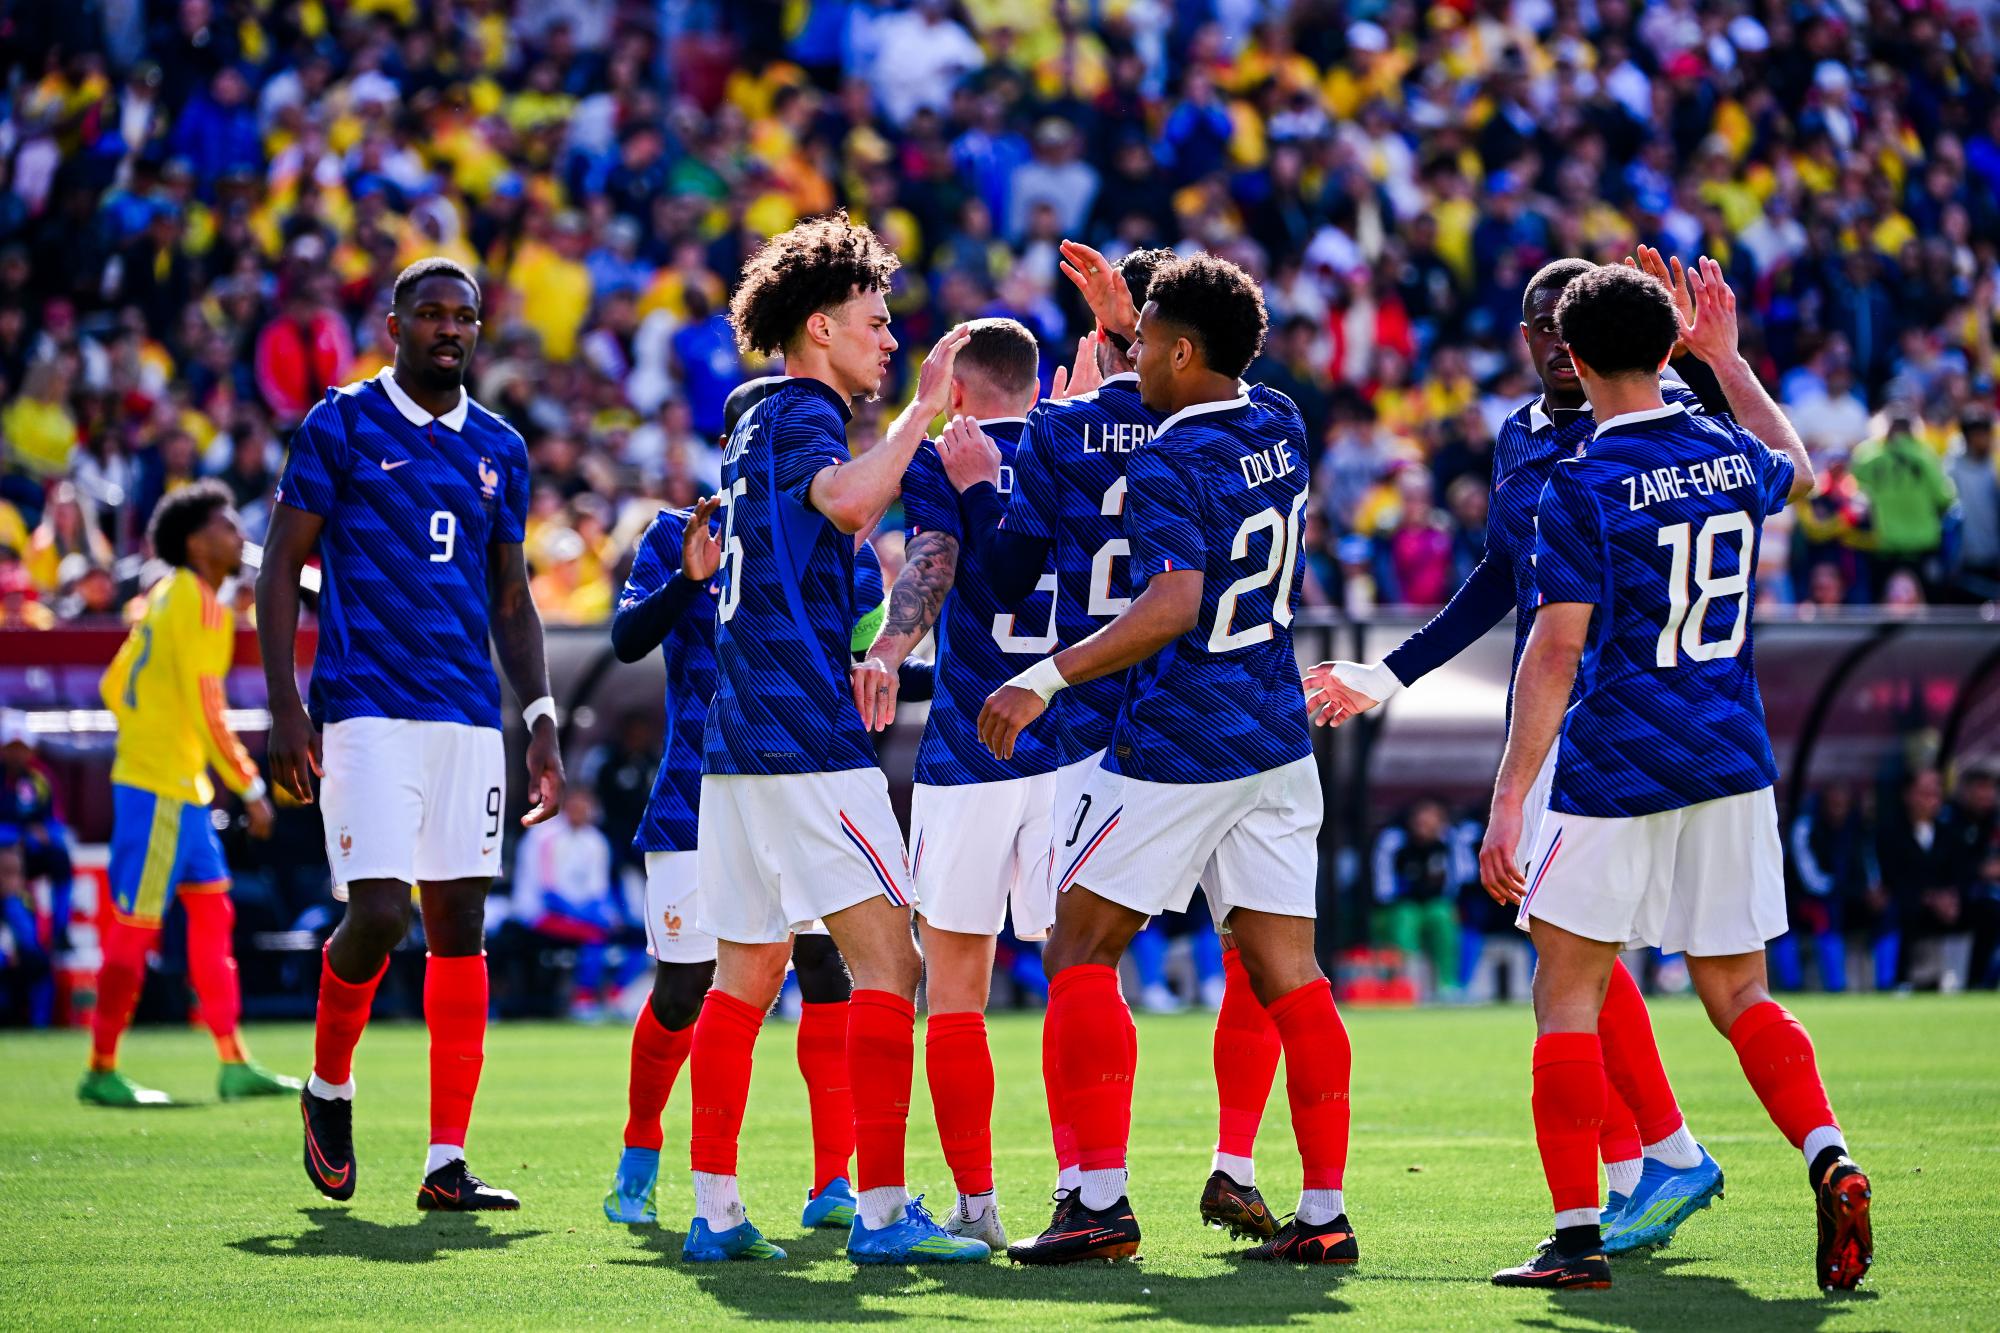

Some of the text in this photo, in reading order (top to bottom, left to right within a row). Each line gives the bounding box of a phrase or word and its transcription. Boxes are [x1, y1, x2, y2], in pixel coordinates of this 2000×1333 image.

[429, 510, 456, 563] 9
[1655, 510, 1755, 668] 18
[486, 787, 501, 838] 9
